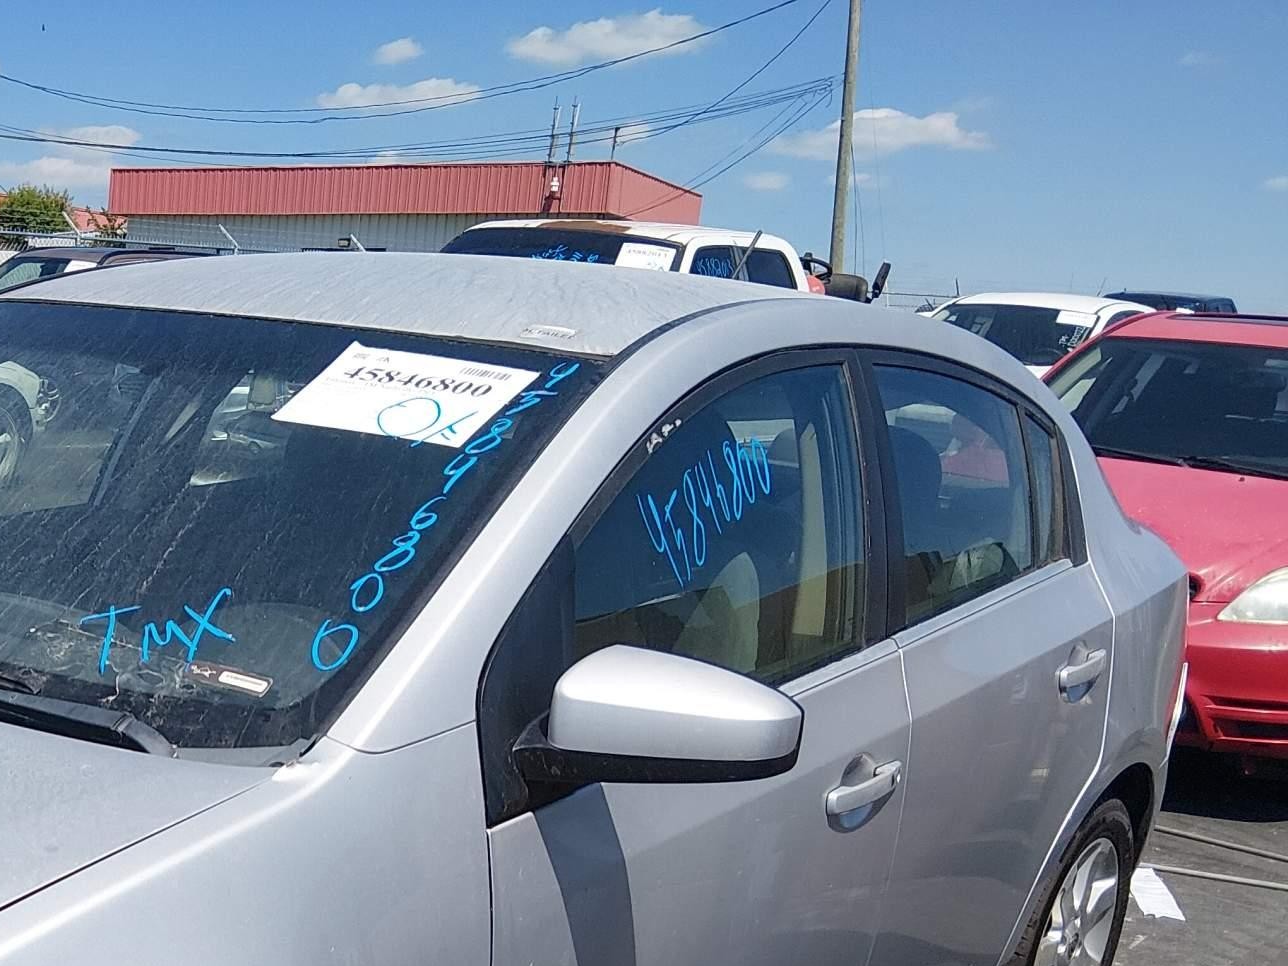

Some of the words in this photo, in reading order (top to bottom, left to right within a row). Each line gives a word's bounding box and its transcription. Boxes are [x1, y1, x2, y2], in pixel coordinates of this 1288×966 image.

[344, 366, 493, 397] 45846800
[637, 436, 771, 587] 45846800
[79, 586, 236, 677] TMX
